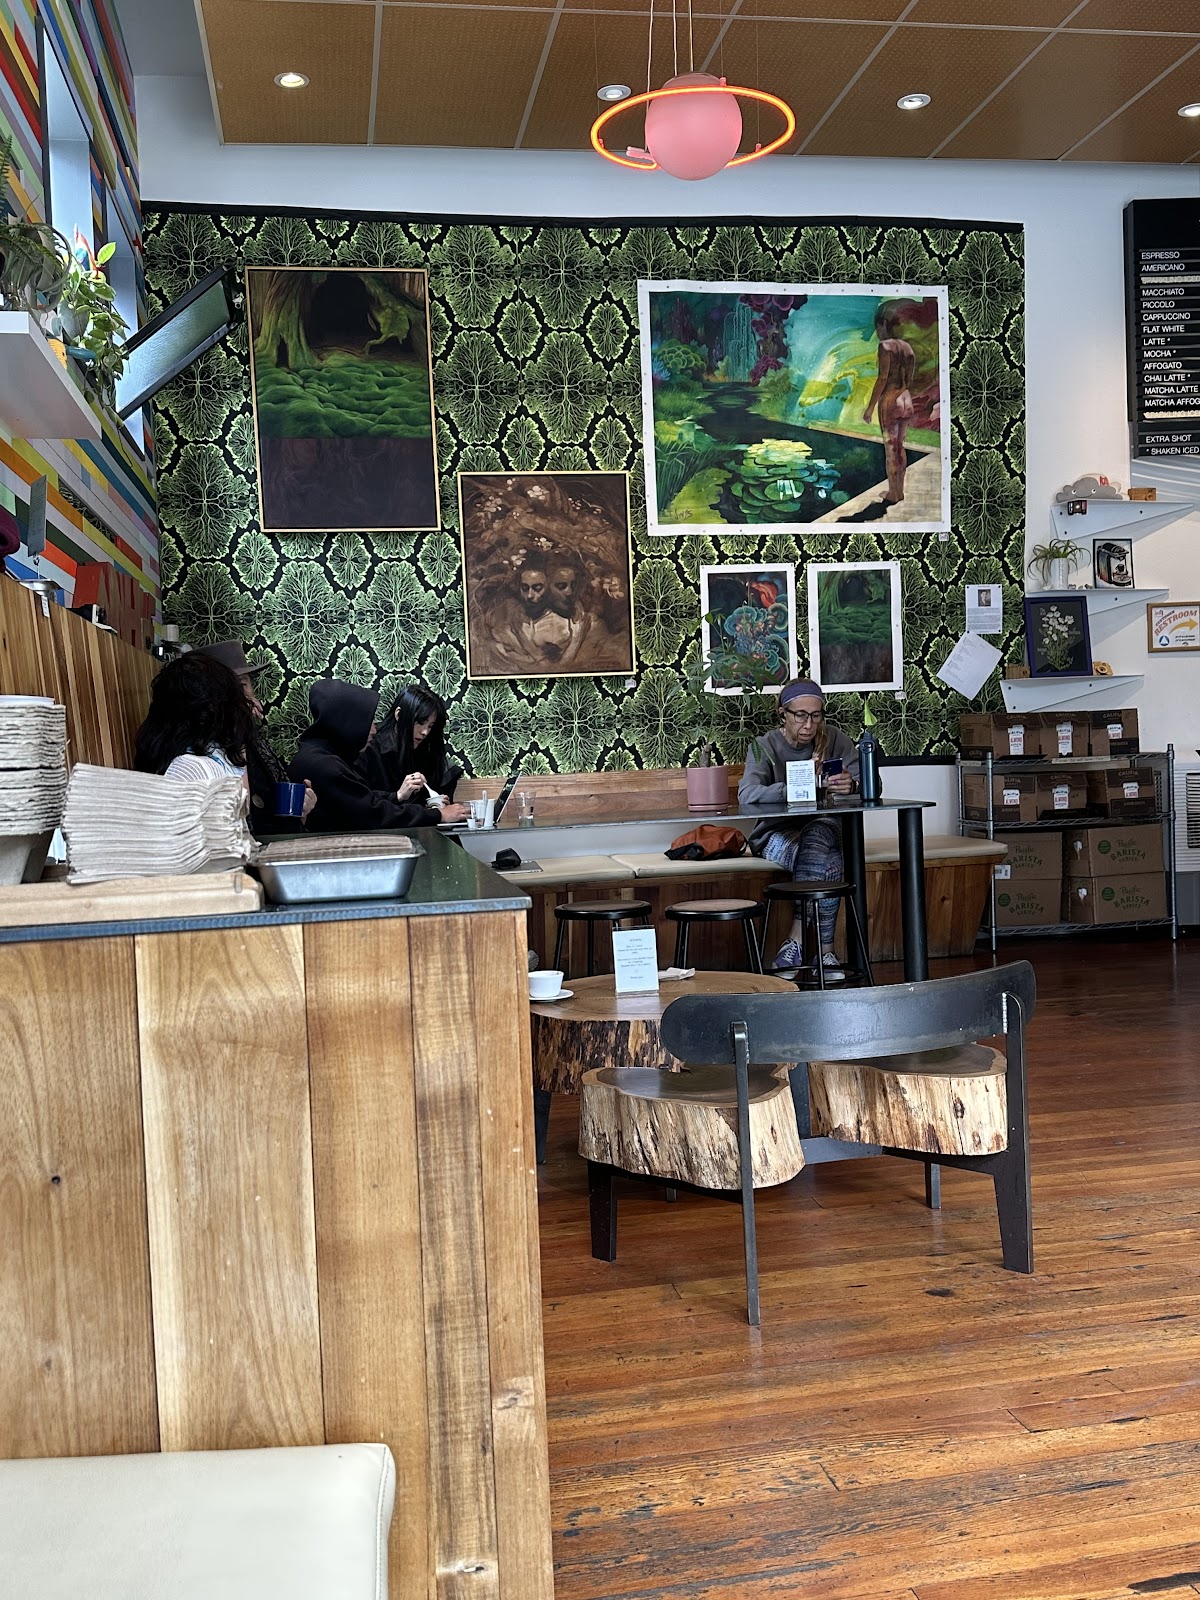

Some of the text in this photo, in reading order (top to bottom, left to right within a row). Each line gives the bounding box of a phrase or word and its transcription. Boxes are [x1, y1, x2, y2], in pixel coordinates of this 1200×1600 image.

[1141, 251, 1180, 260] ESPRESSO
[1141, 263, 1186, 272] AMERICANO
[1142, 288, 1185, 297] MACCHIATO
[1142, 300, 1175, 309] PICCOLO
[1142, 312, 1191, 321] CAPPUCCINO
[1143, 324, 1185, 334] FLAT WHITE
[1143, 337, 1166, 346] LATTE
[1143, 350, 1171, 358] MOCHA
[1144, 361, 1183, 370] AFFOGATO
[1163, 373, 1186, 382] LATTE
[1144, 385, 1199, 395] MATCHA LATTE
[1144, 398, 1175, 407] MATCHA
[1145, 434, 1192, 444] EXTRA SHOT
[1150, 446, 1200, 455] SHAKEN ICED
[1154, 609, 1198, 636] RESTROOM
[1110, 849, 1146, 861] BARISTA
[1006, 856, 1043, 866] BARISTA
[1114, 895, 1150, 908] BARISTA
[1009, 902, 1044, 914] BARISTA
